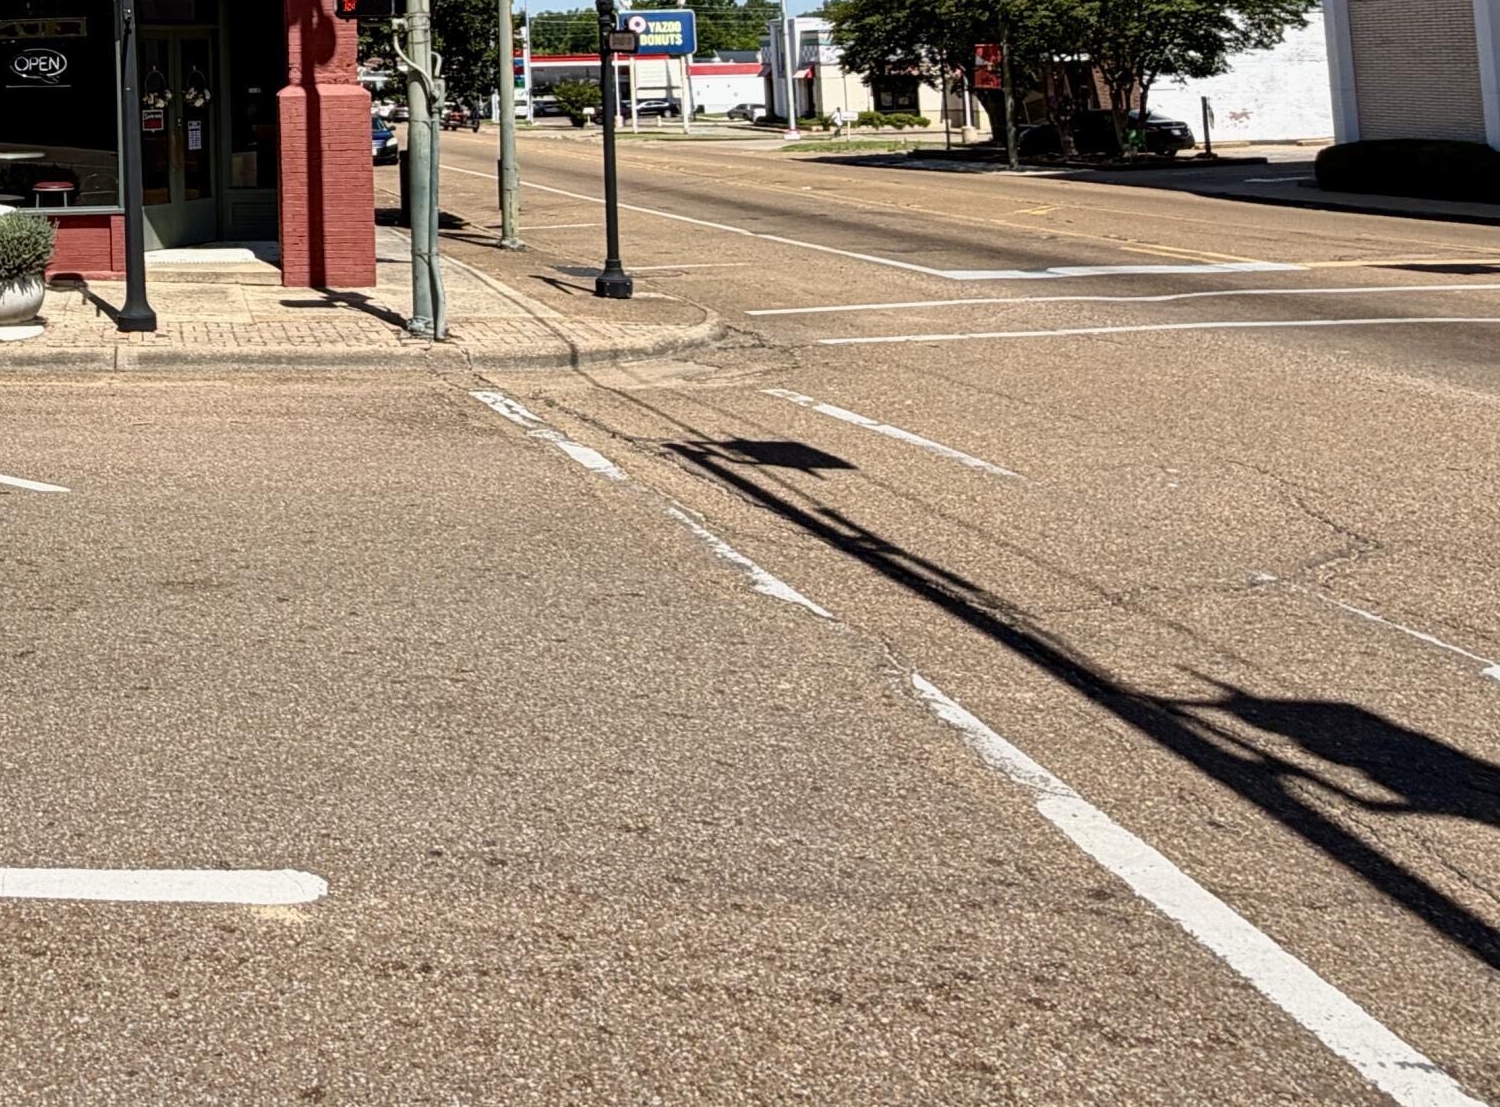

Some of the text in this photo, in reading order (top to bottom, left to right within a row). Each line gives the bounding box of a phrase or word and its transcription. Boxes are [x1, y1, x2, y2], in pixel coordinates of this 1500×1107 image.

[647, 21, 682, 33] YAZOO
[639, 34, 683, 46] DONUTS
[14, 56, 60, 72] OPEN
